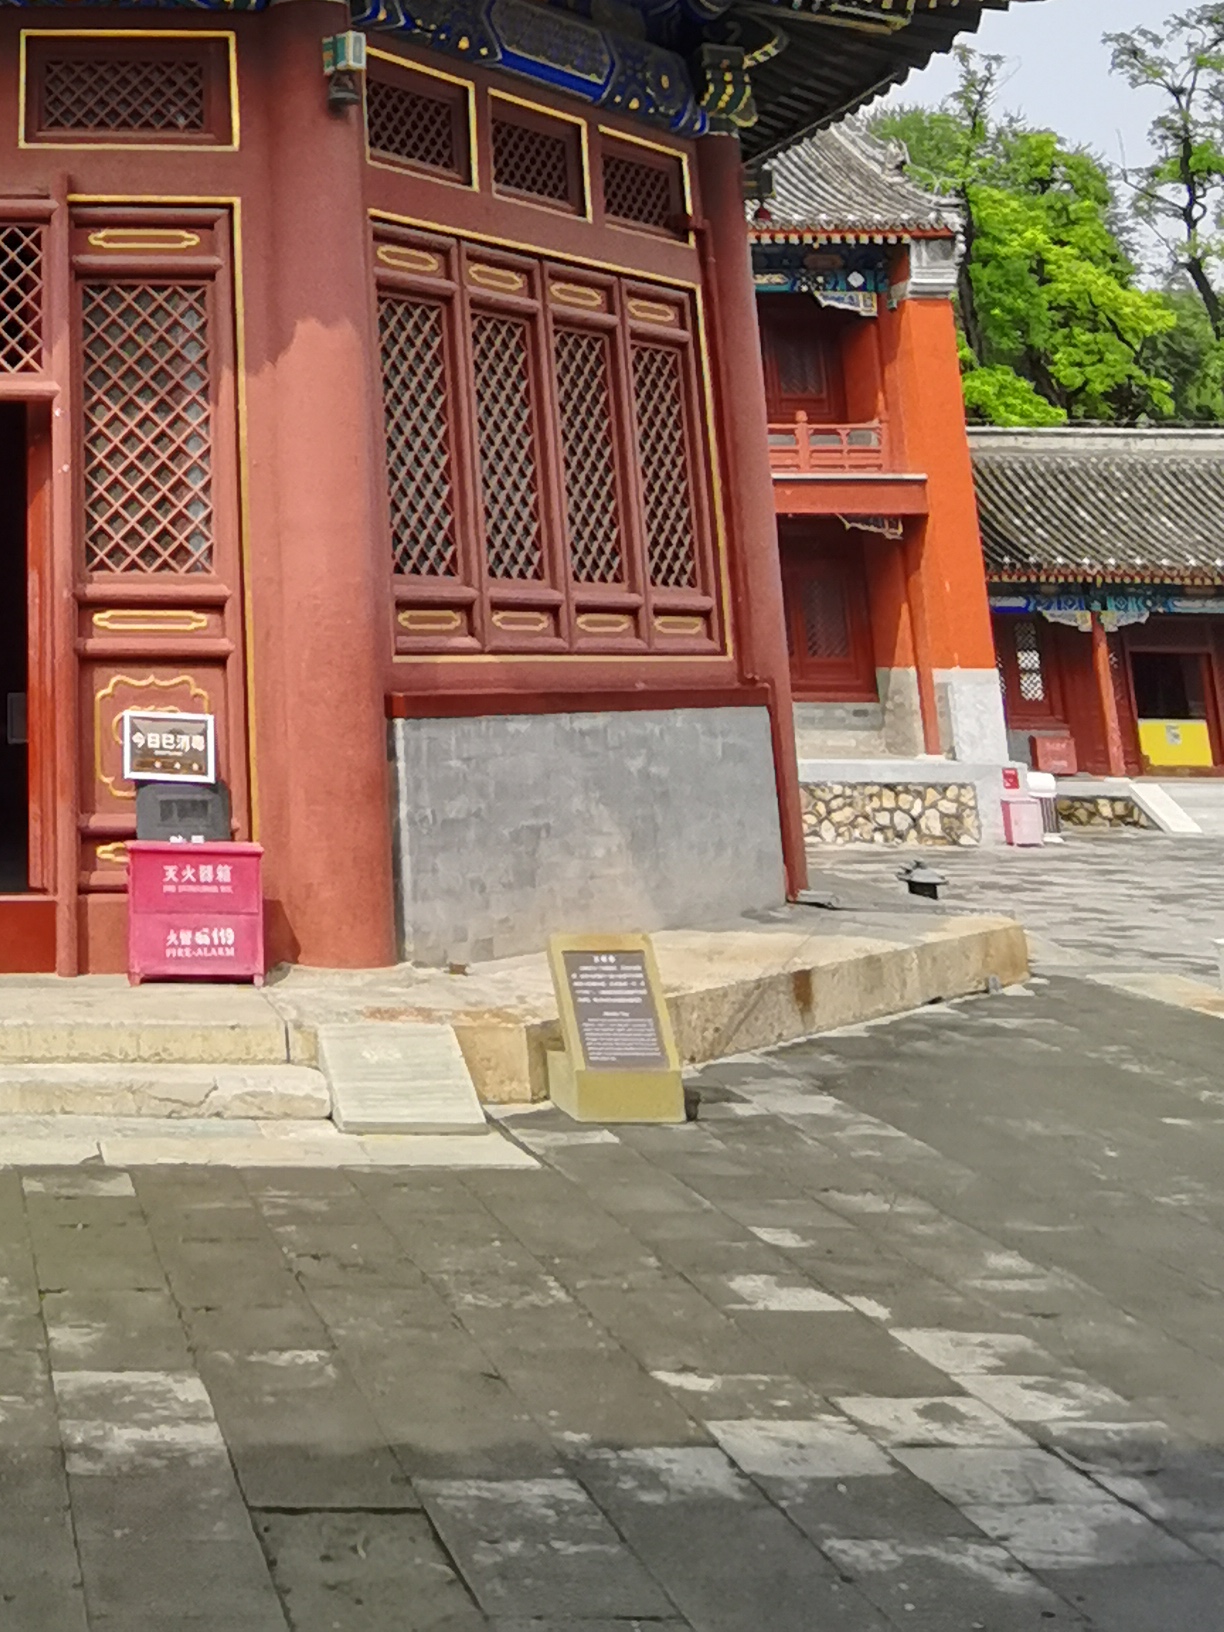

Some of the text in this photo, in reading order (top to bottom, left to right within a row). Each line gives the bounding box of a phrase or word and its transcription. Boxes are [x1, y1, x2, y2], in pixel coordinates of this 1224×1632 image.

[131, 732, 206, 753] 今日已消毒
[162, 863, 234, 883] 灭火器箱
